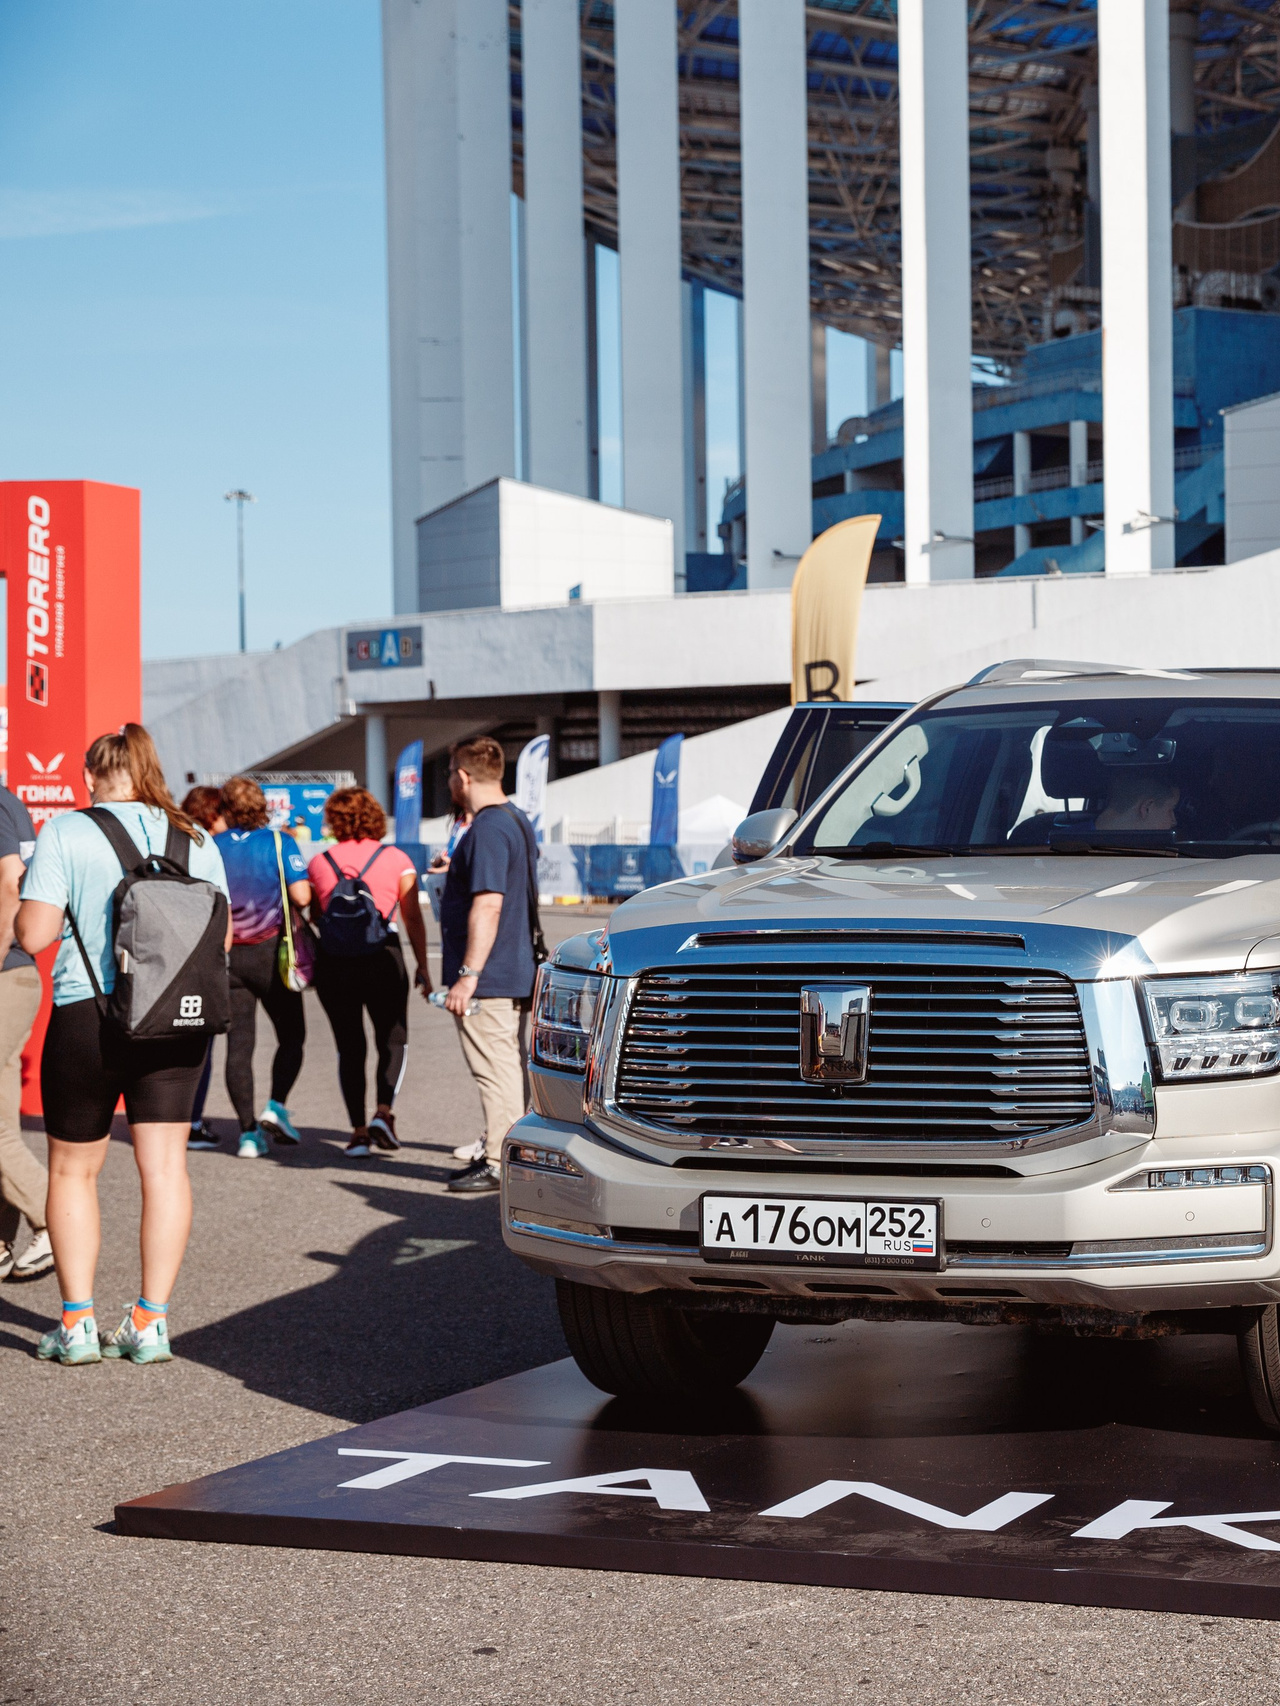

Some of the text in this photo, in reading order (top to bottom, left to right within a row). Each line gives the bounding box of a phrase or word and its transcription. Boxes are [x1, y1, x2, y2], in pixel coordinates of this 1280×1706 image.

[26, 495, 51, 658] TORERO
[381, 632, 399, 663] A
[17, 784, 75, 802] ГОНКА
[810, 1061, 855, 1073] ANK
[869, 1206, 926, 1239] 252
[884, 1240, 912, 1252] RUS
[795, 1253, 826, 1262] TANK
[864, 1257, 881, 1265] (831)
[886, 1257, 900, 1265] 000
